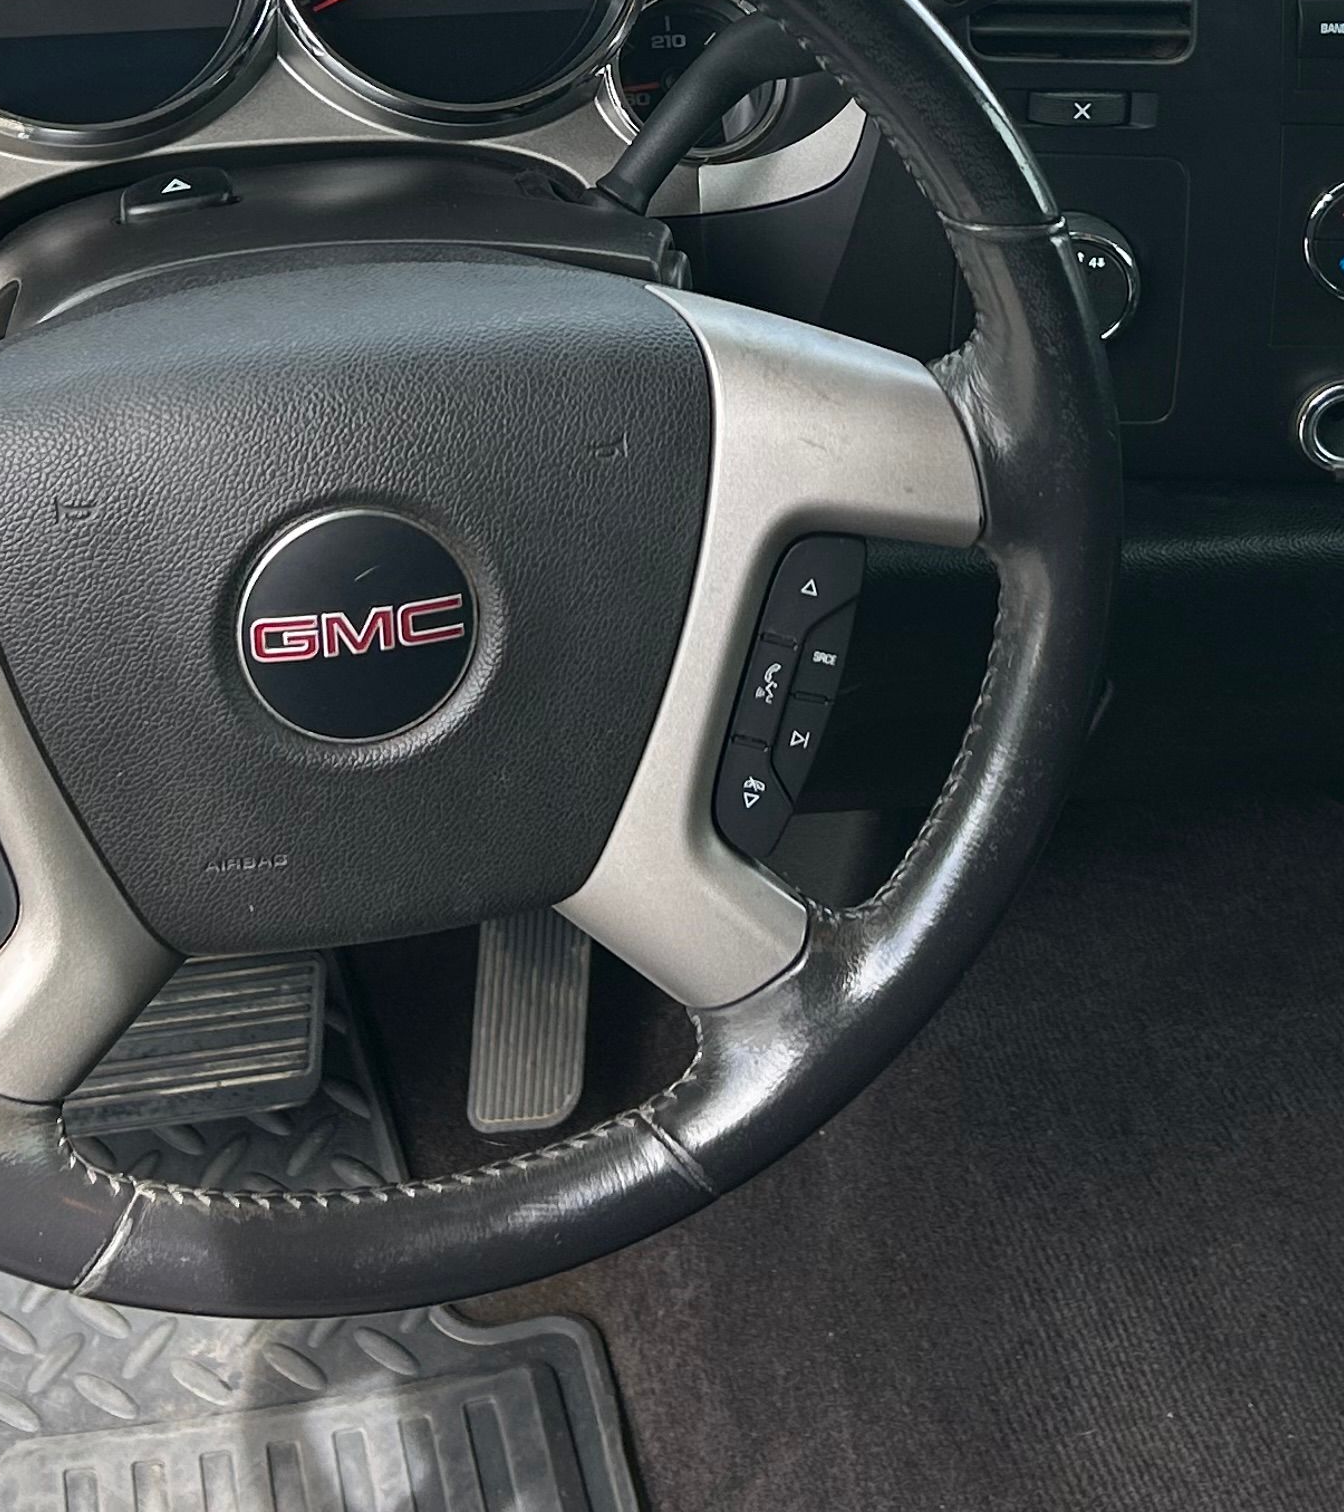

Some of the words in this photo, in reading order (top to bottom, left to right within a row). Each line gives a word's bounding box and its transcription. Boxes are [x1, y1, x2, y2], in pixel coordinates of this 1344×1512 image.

[651, 35, 687, 49] 210
[250, 593, 465, 663] GMC
[812, 650, 837, 666] SRCE
[204, 854, 289, 873] AIRBAG
